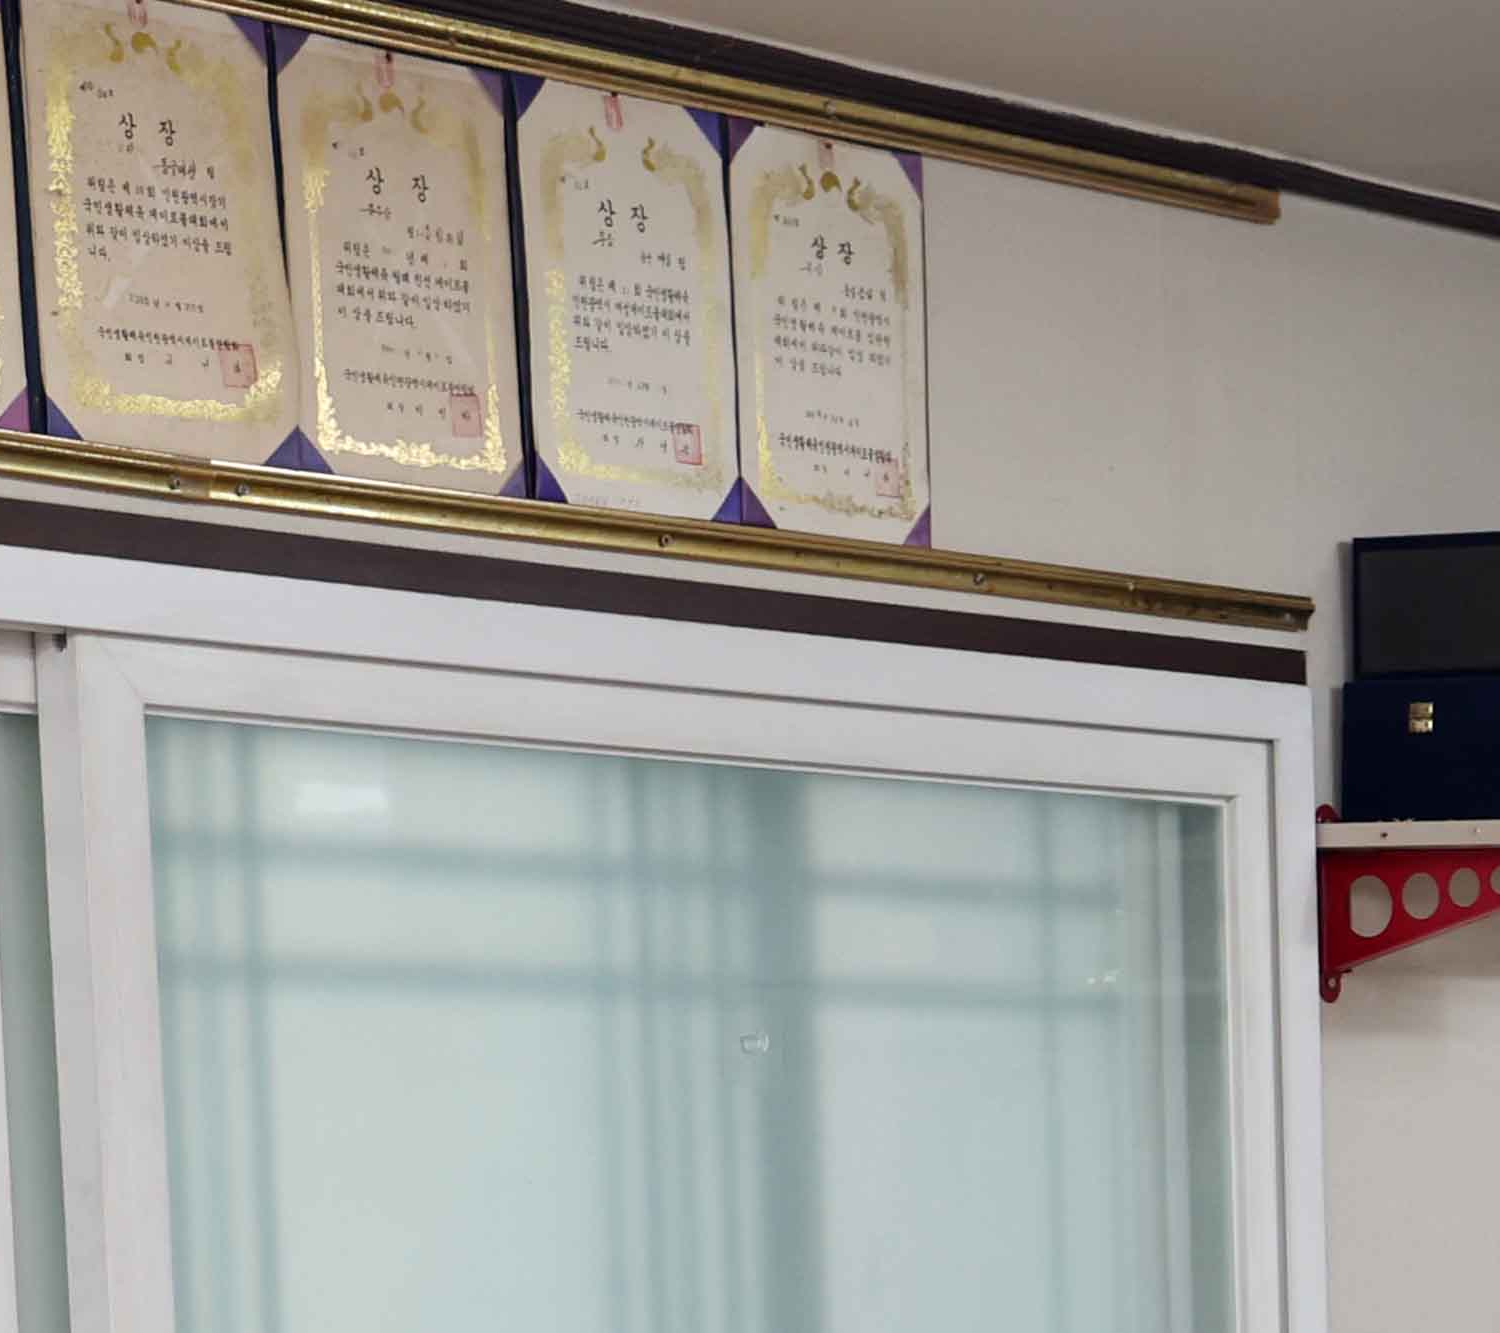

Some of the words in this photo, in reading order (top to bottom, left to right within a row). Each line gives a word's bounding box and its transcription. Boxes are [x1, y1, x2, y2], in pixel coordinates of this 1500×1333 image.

[118, 112, 137, 140] 상
[159, 120, 177, 146] 장
[366, 167, 385, 195] 상
[412, 175, 429, 203] 장
[598, 199, 616, 227] 상
[630, 204, 648, 233] 장
[811, 234, 827, 260] 상
[837, 241, 855, 265] 장
